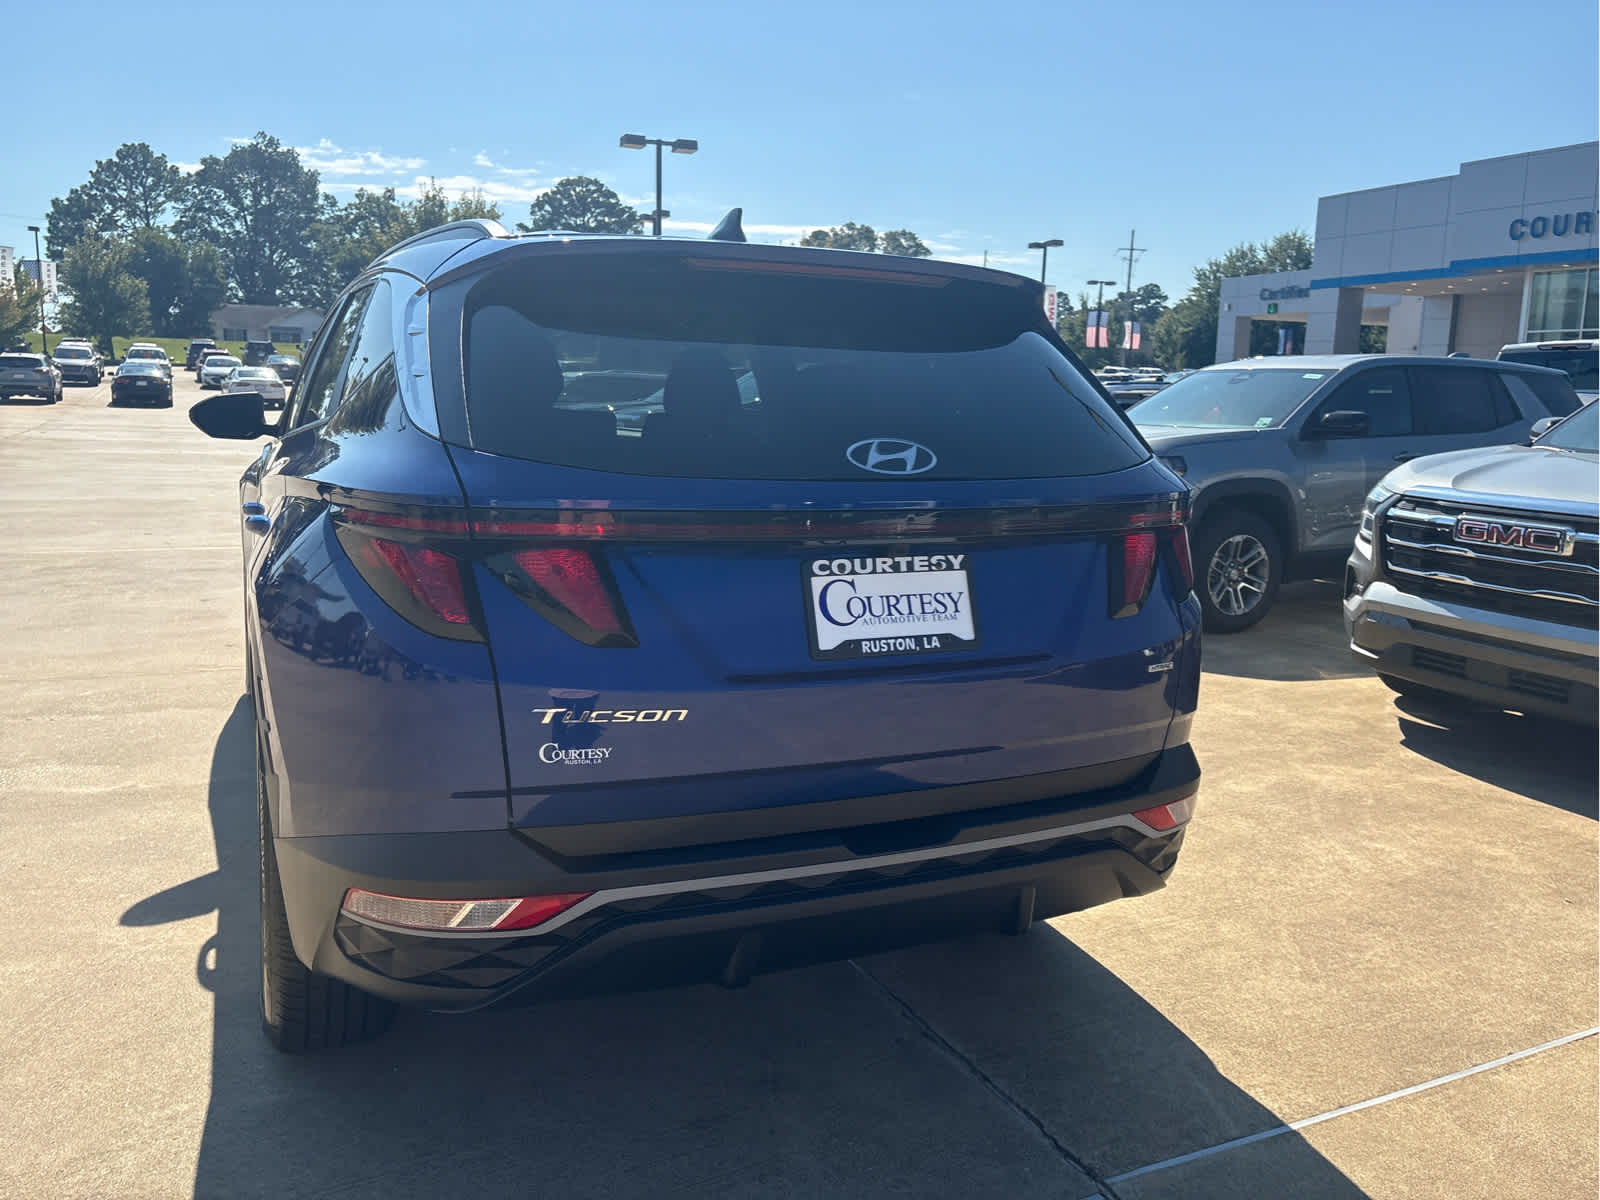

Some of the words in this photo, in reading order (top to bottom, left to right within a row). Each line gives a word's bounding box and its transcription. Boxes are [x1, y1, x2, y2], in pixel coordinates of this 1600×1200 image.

[1509, 211, 1600, 241] COUR
[1457, 520, 1561, 552] GMC
[812, 554, 965, 576] COURTESY
[818, 578, 964, 627] COURTESY
[862, 614, 928, 626] AUTOMOTIVE
[932, 612, 958, 622] TEAM
[861, 637, 920, 653] RUSTON,
[923, 635, 941, 649] LA
[539, 742, 613, 763] COURTESY
